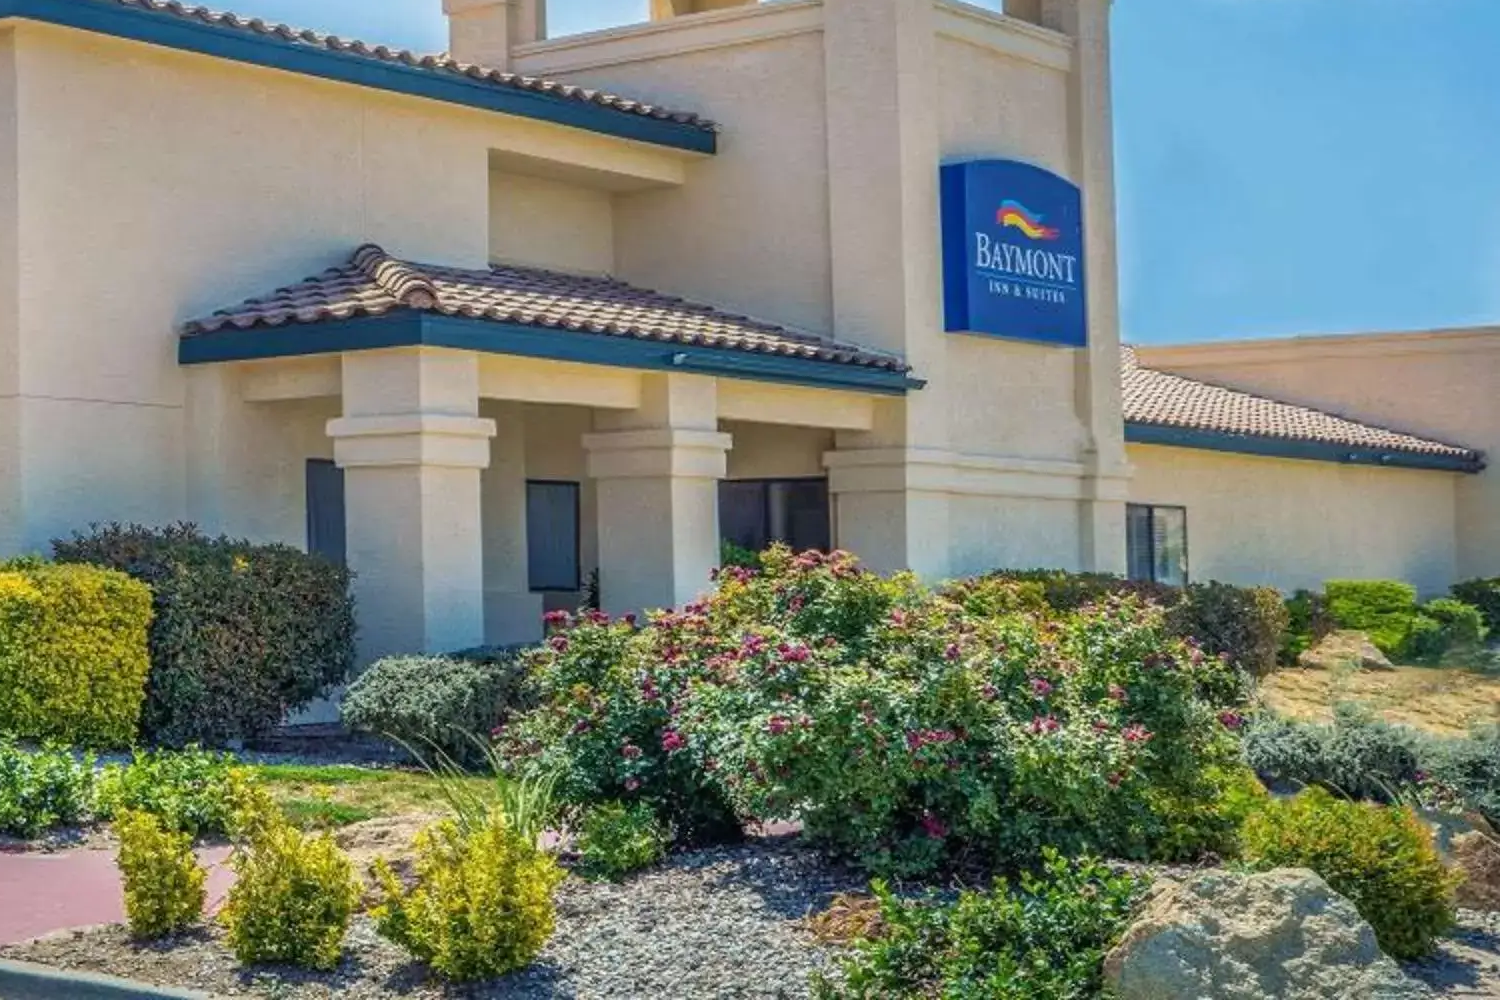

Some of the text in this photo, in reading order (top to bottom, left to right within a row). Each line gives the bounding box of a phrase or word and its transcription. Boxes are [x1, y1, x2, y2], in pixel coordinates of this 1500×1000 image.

[975, 231, 1077, 283] BAYMONT
[989, 279, 1066, 304] INN & SUITES
